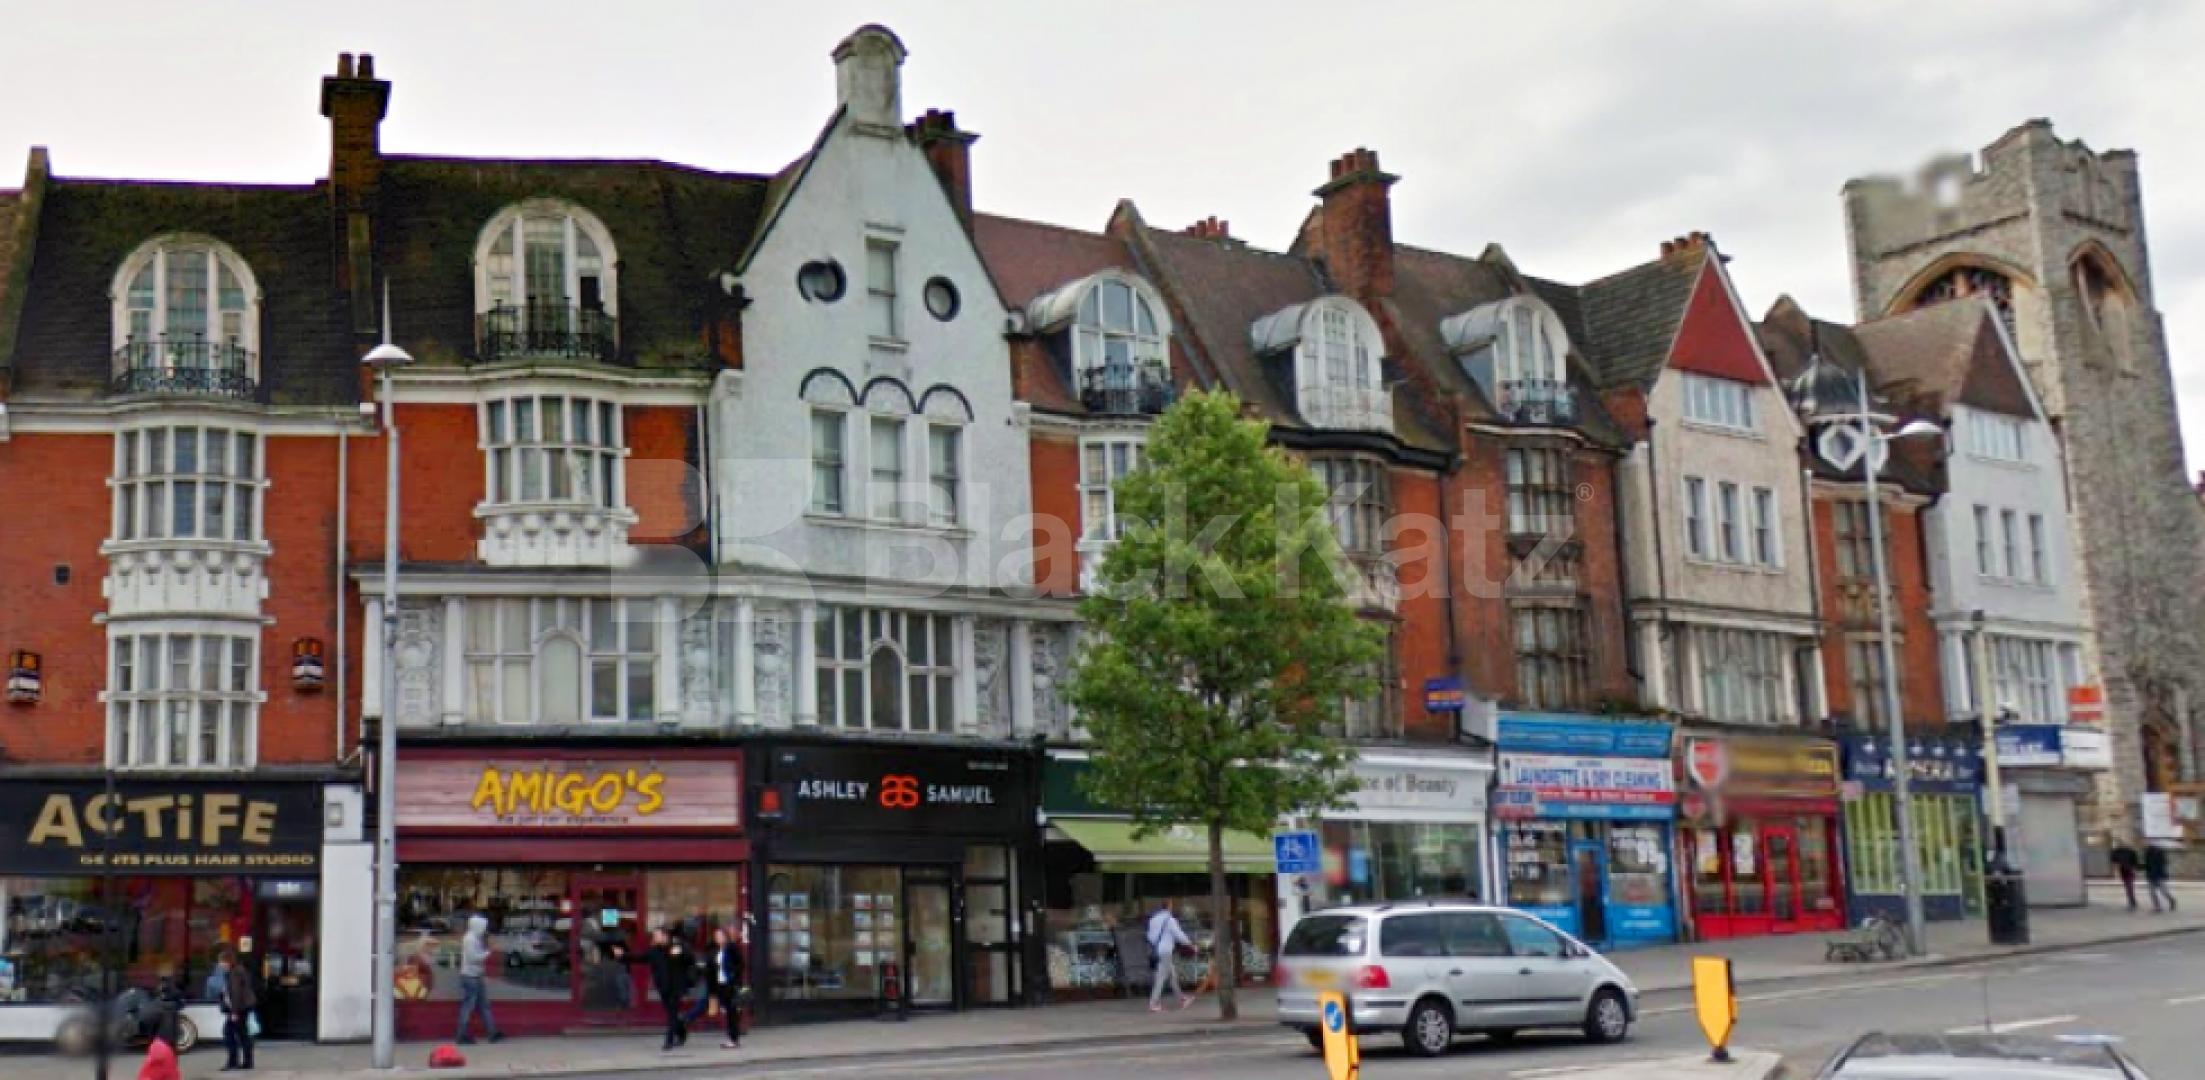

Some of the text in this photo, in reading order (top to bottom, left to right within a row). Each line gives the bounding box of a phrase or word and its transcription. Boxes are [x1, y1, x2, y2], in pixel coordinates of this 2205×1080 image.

[471, 766, 666, 816] AMIGO'S
[798, 780, 869, 799] ASHLEY
[926, 784, 995, 804] SAMUEL
[194, 854, 241, 865] HAIR
[244, 854, 314, 865] STUDIO
